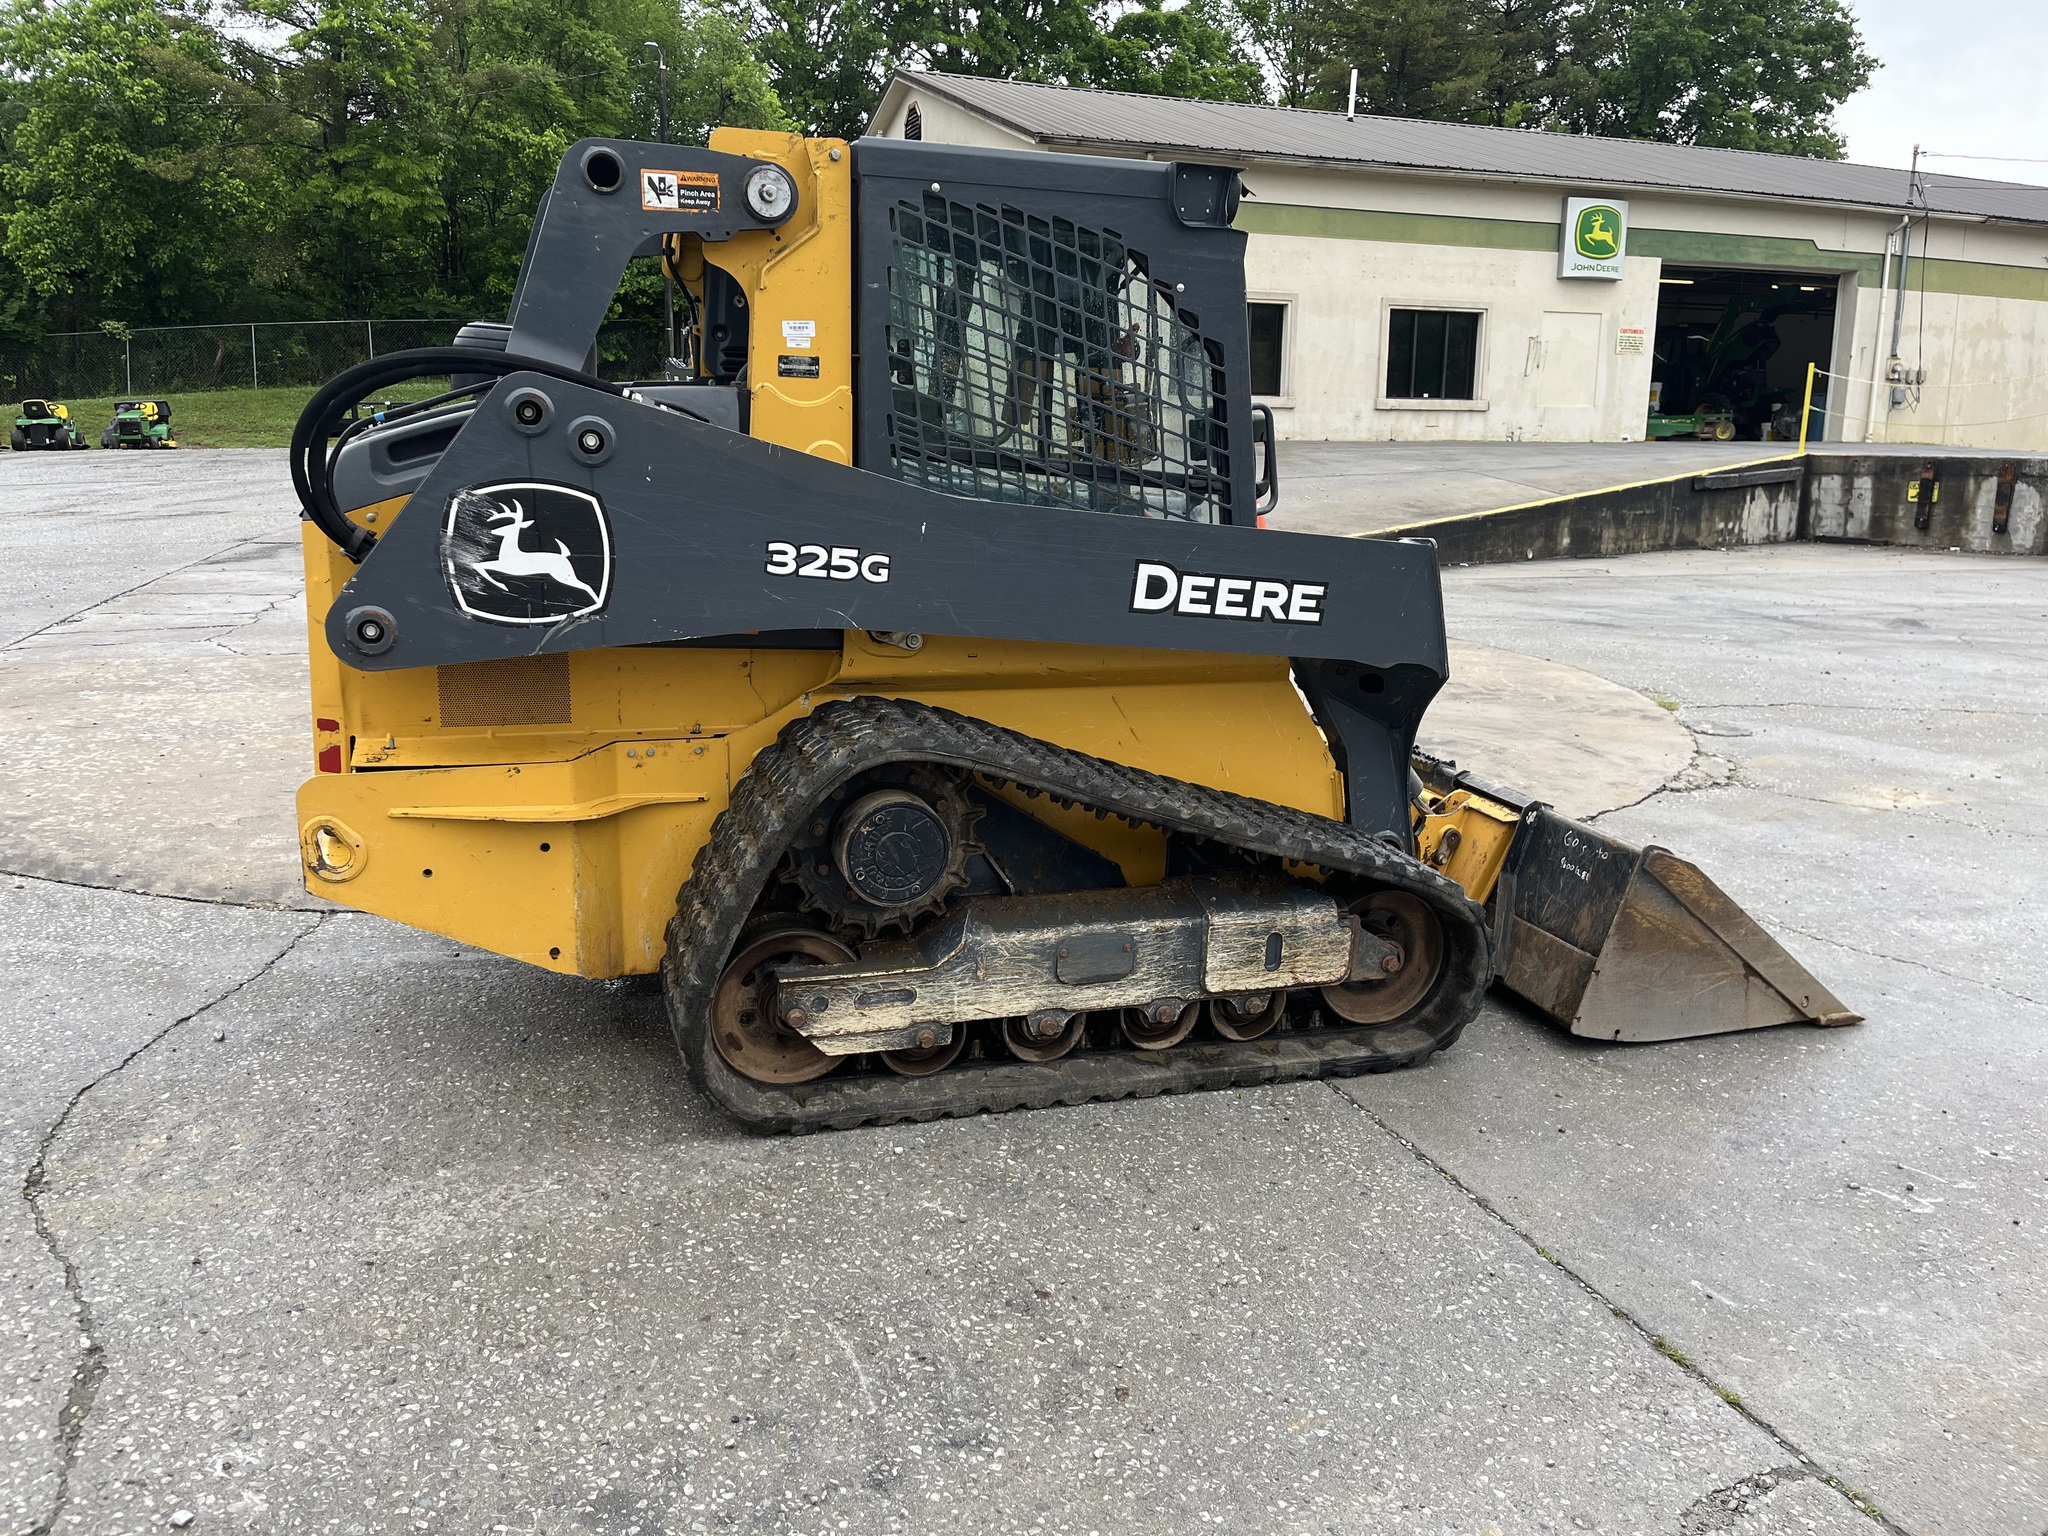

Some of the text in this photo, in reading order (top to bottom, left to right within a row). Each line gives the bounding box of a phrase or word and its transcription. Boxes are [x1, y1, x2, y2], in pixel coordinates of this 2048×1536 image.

[686, 176, 716, 184] WARNING
[680, 189, 716, 198] Pinch Area
[680, 198, 711, 207] Keep Away
[1570, 262, 1620, 273] JOHN DEERE
[765, 541, 891, 583] 325G
[1131, 561, 1326, 623] DEERE
